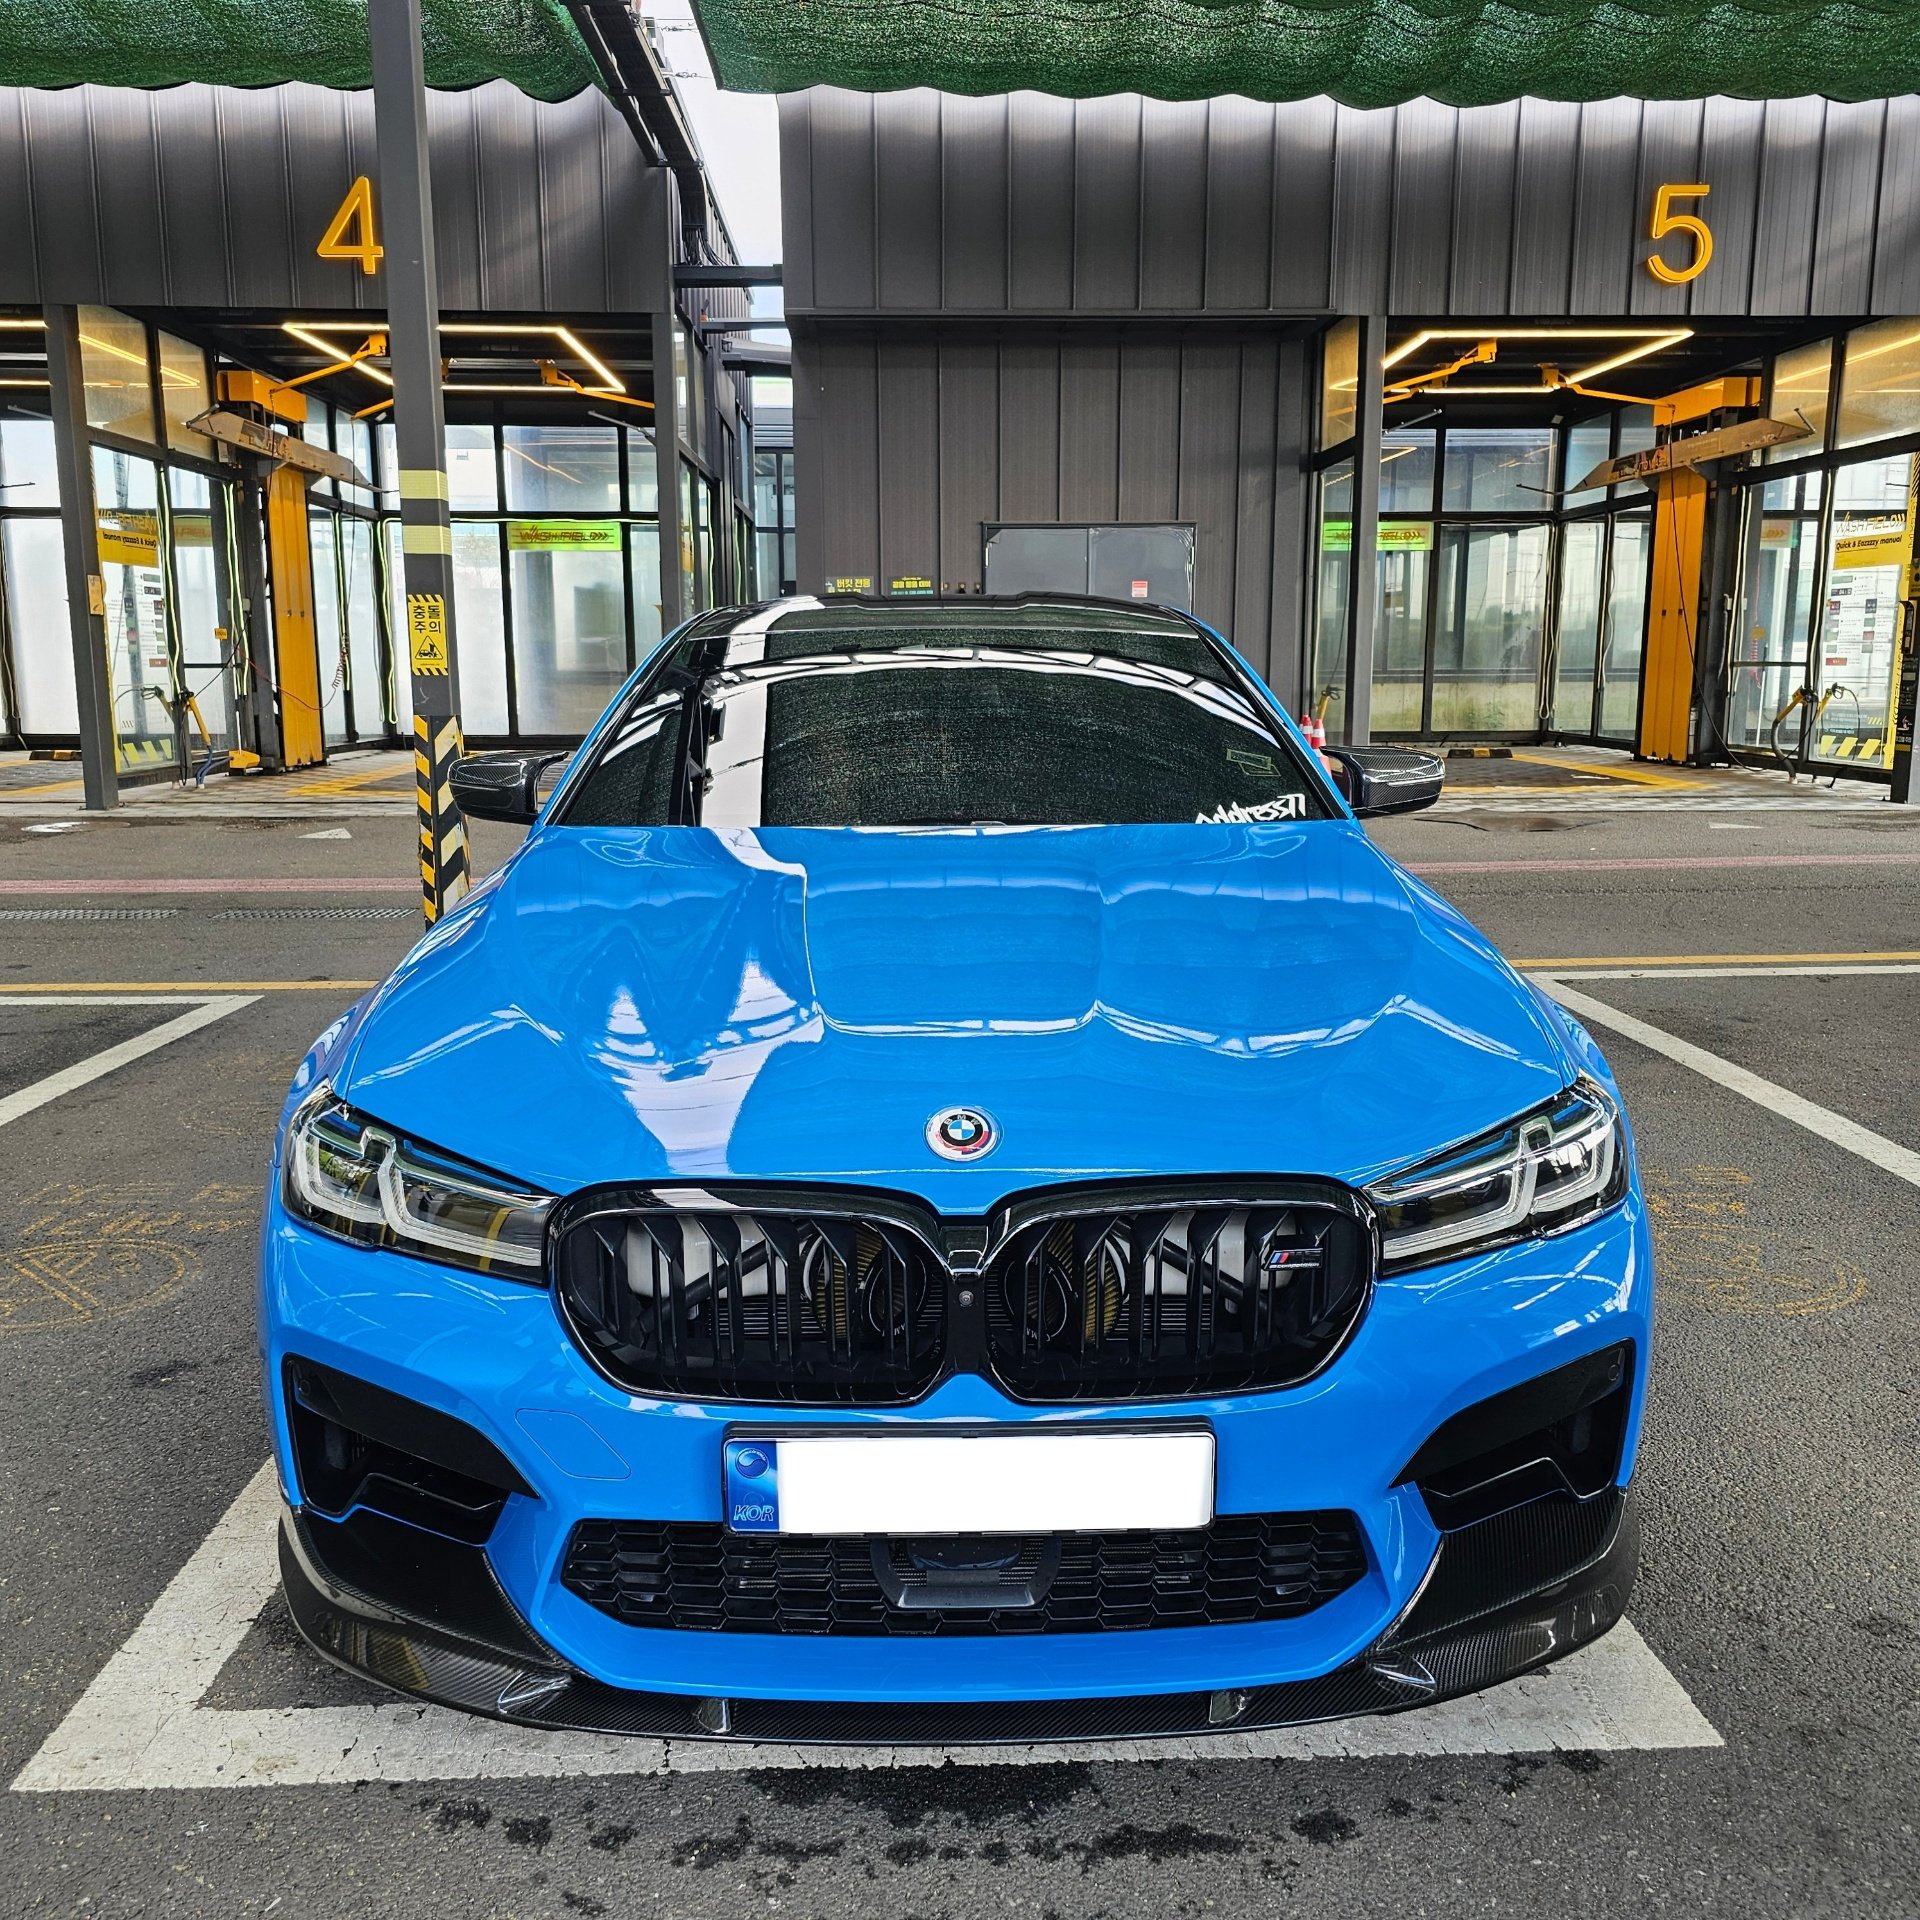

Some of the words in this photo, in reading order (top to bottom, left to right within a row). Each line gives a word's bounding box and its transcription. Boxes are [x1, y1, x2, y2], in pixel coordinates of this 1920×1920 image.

[317, 176, 384, 274] 4
[1648, 184, 1713, 283] 5
[1836, 540, 1851, 550] Quick
[1880, 534, 1903, 544] manual
[413, 605, 440, 620] 충돌
[414, 621, 441, 634] 주의
[943, 1113, 981, 1126] BMW
[733, 1504, 775, 1521] KOR
